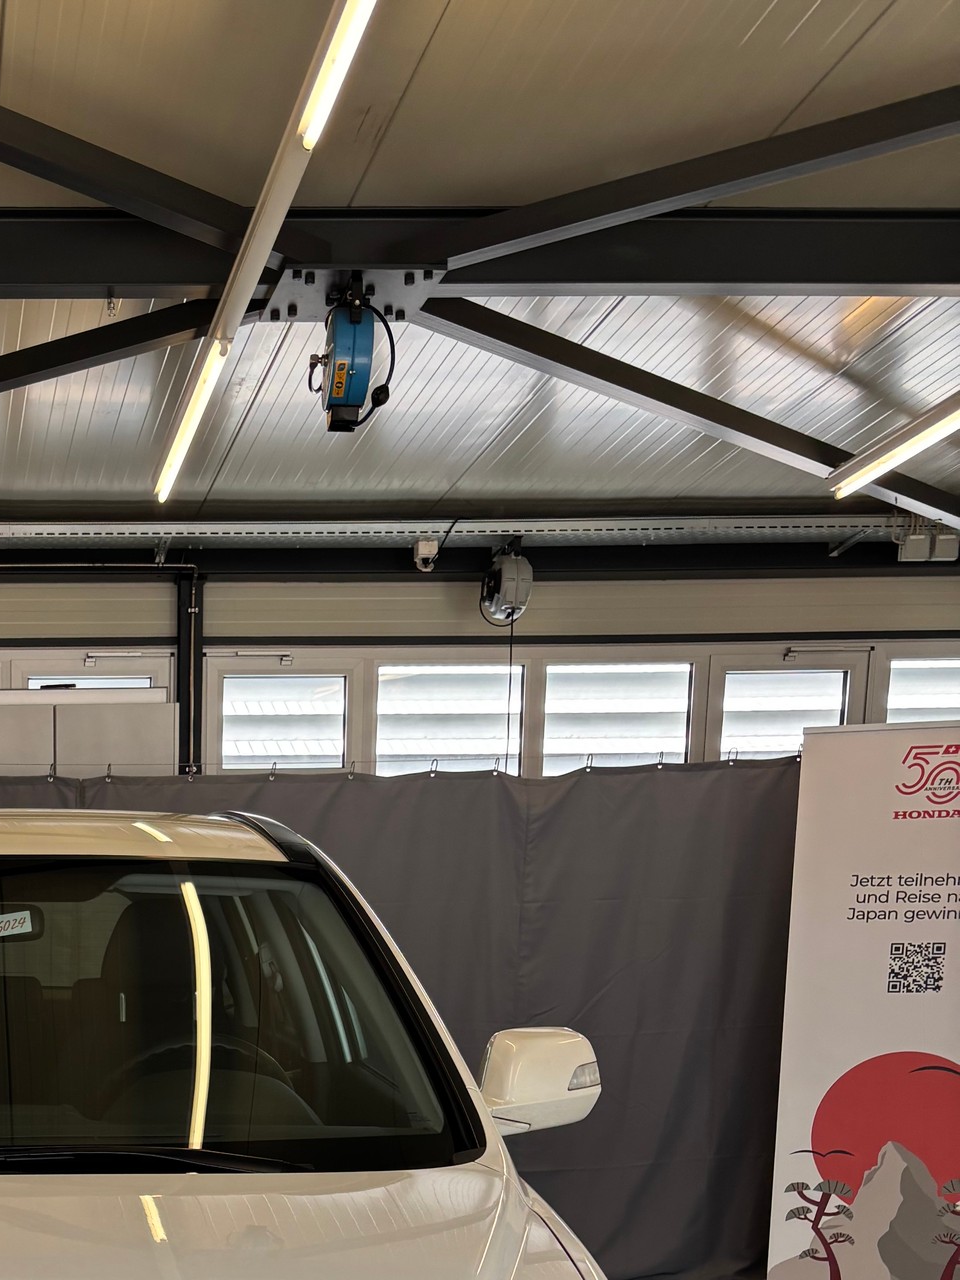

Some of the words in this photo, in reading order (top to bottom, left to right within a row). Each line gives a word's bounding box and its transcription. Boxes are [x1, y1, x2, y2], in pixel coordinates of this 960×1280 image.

[938, 778, 954, 786] TH
[850, 874, 893, 887] Jetzt
[897, 872, 960, 887] teilneh
[856, 889, 890, 904] und
[895, 889, 942, 904] Reise
[947, 893, 960, 903] n
[846, 907, 898, 923] Japan
[903, 906, 960, 923] gewin
